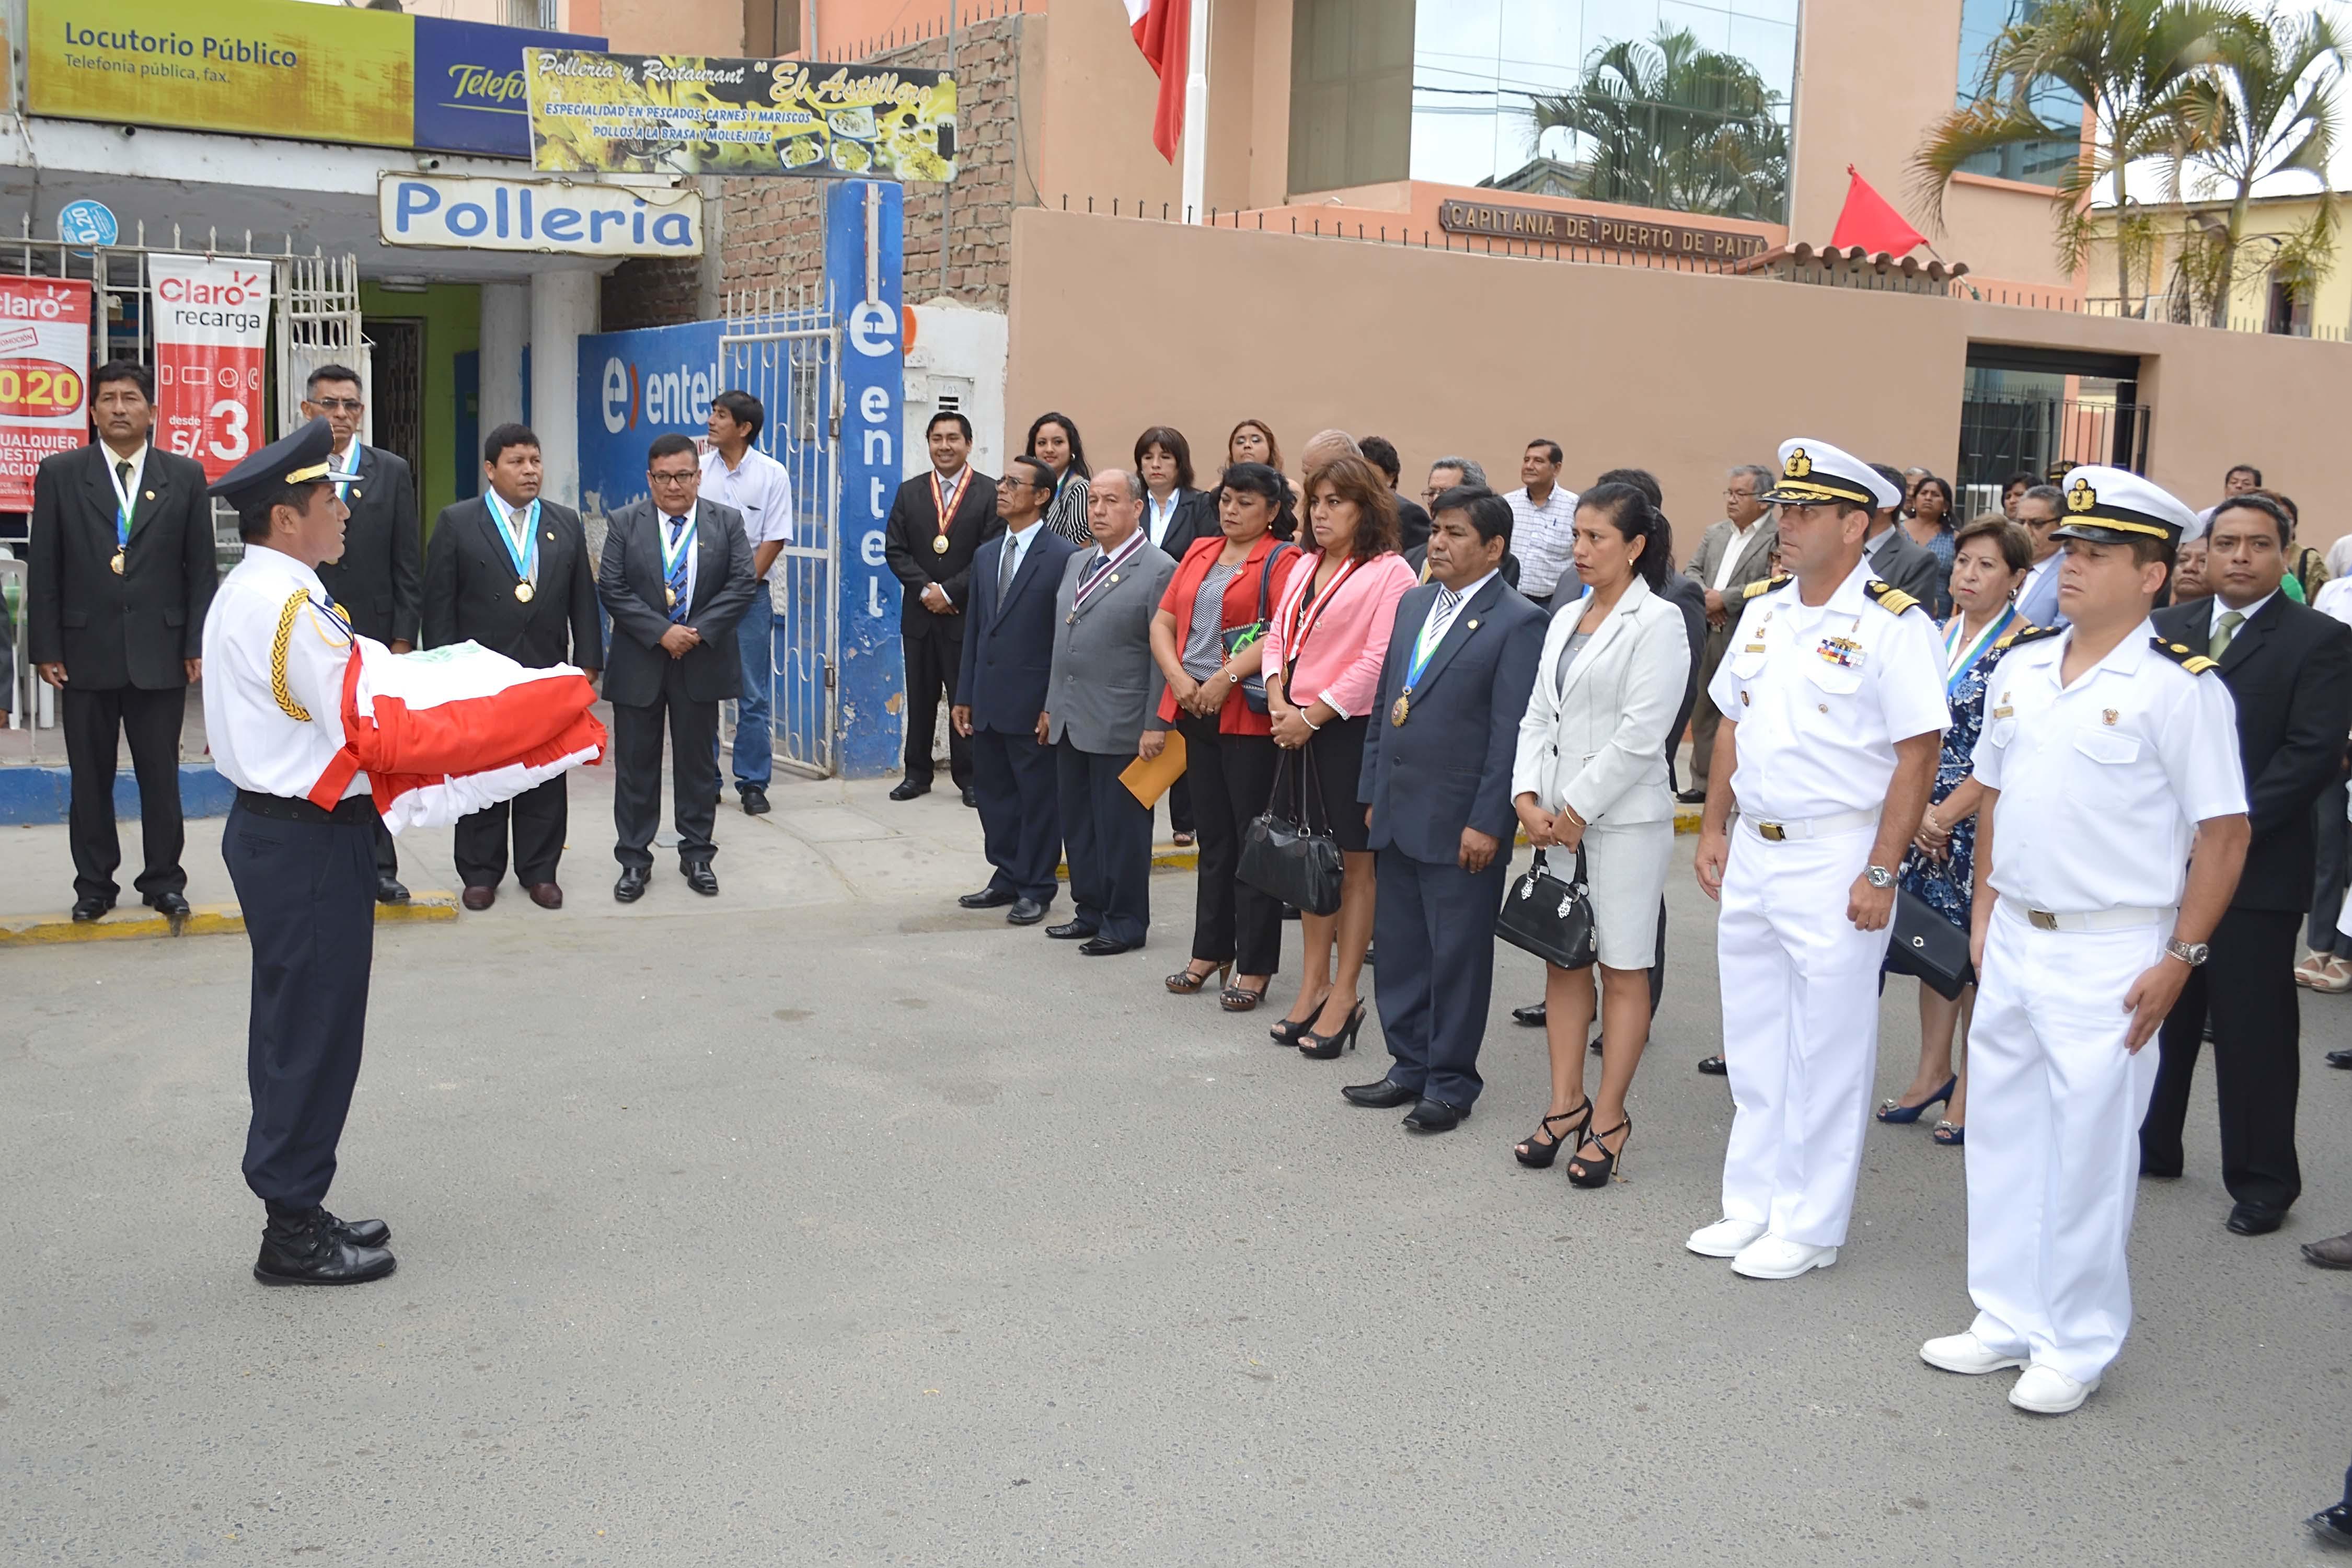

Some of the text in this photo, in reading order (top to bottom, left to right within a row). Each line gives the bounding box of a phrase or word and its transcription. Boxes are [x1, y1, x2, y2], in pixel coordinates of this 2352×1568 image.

[65, 22, 297, 67] Locutorio Público
[203, 67, 230, 84] fax.
[538, 53, 615, 77] Polleria
[622, 66, 634, 84] y
[642, 59, 745, 84] Restaurant
[545, 103, 811, 123] ESPECIALIDAD EN PESCADOS, CARNES Y MARISCOS
[593, 126, 771, 143] POLLOS A LA BRASA Y MOLLEJITAS
[396, 182, 695, 247] Polleria
[1450, 205, 1764, 257] CAPITANIA DE PUERTO DE PAITA
[0, 292, 60, 318] laro
[159, 277, 245, 306] Claro
[176, 310, 261, 332] recarga
[646, 362, 717, 425] entel
[169, 415, 201, 426] desde
[171, 399, 249, 460] S/. 3
